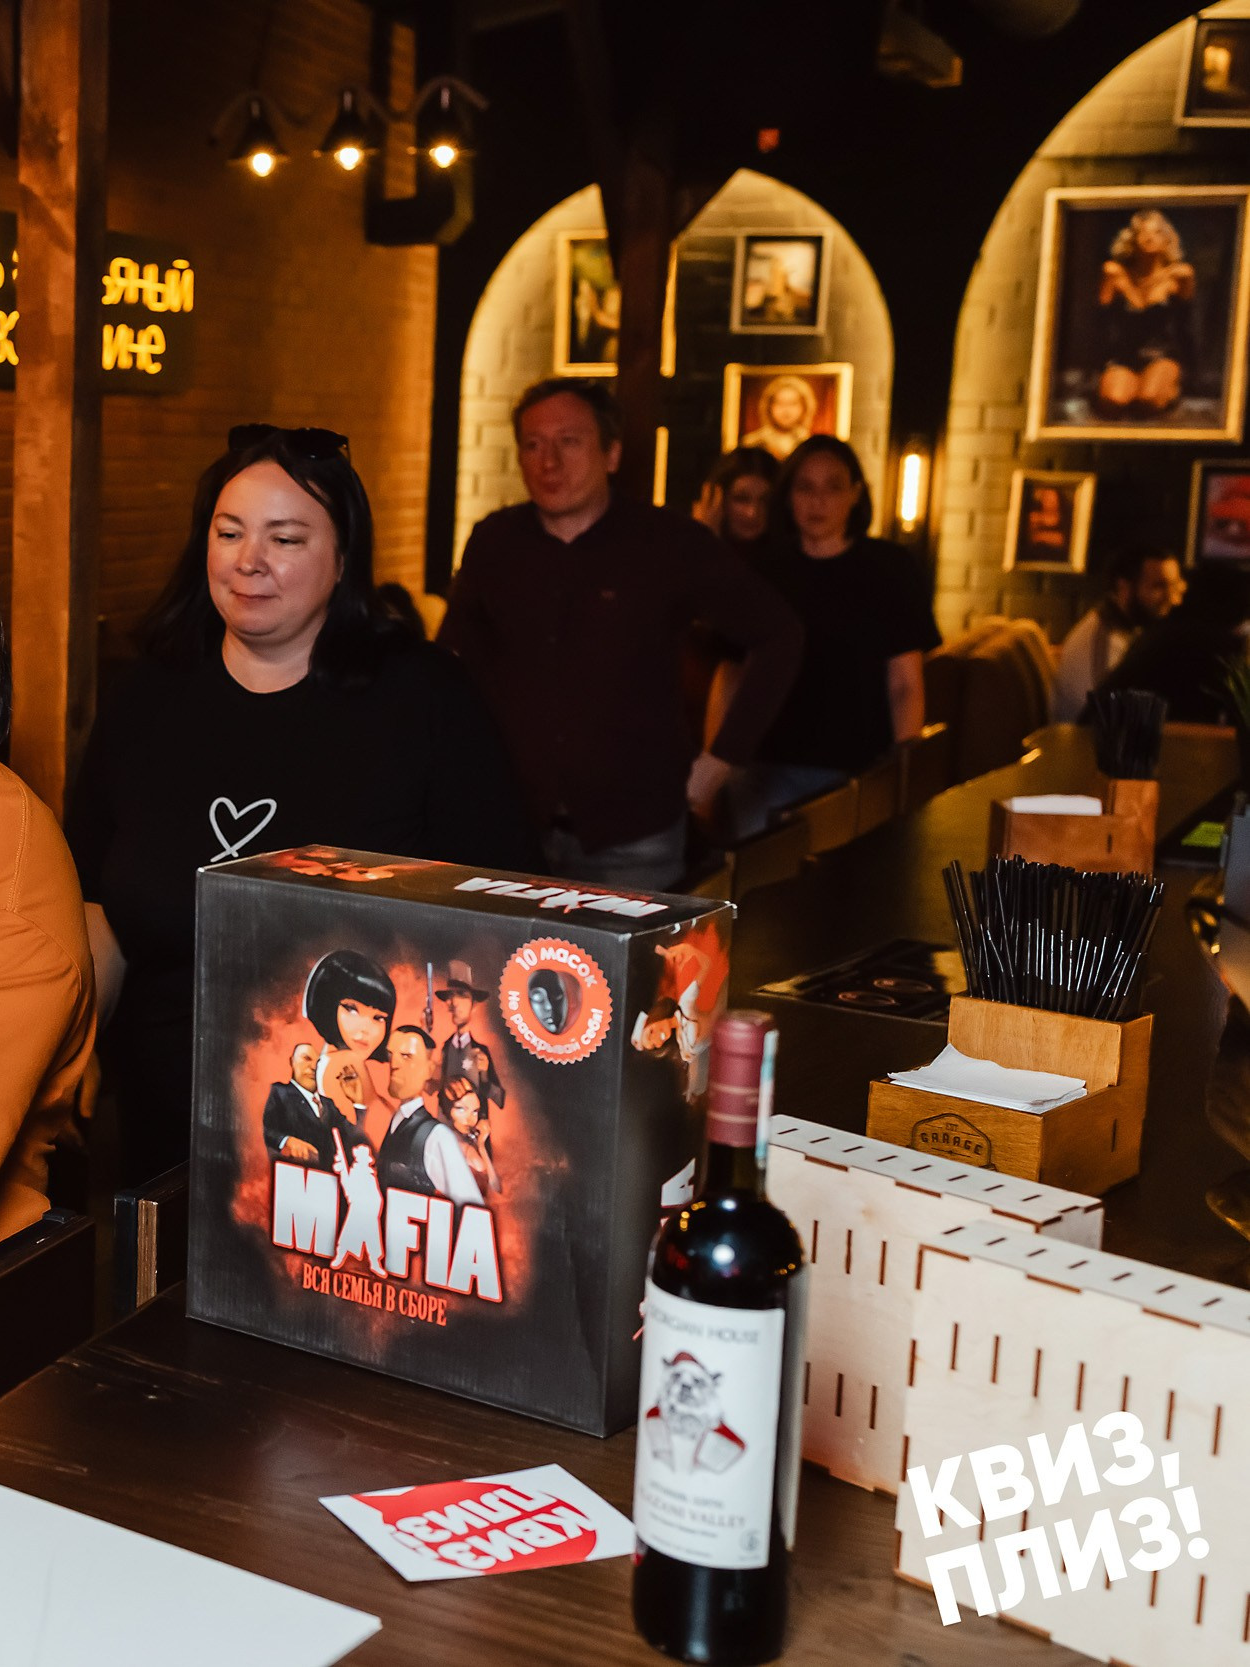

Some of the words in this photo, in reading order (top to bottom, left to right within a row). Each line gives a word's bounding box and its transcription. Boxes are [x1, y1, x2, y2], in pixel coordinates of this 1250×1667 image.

[515, 948, 538, 971] 10
[920, 1132, 984, 1156] GARAGE
[273, 1145, 502, 1303] MAFIA
[302, 1263, 330, 1295] ВСЯ
[333, 1272, 382, 1310] СЕМЬЯ
[385, 1284, 396, 1312] В
[399, 1287, 448, 1327] СБОРЕ
